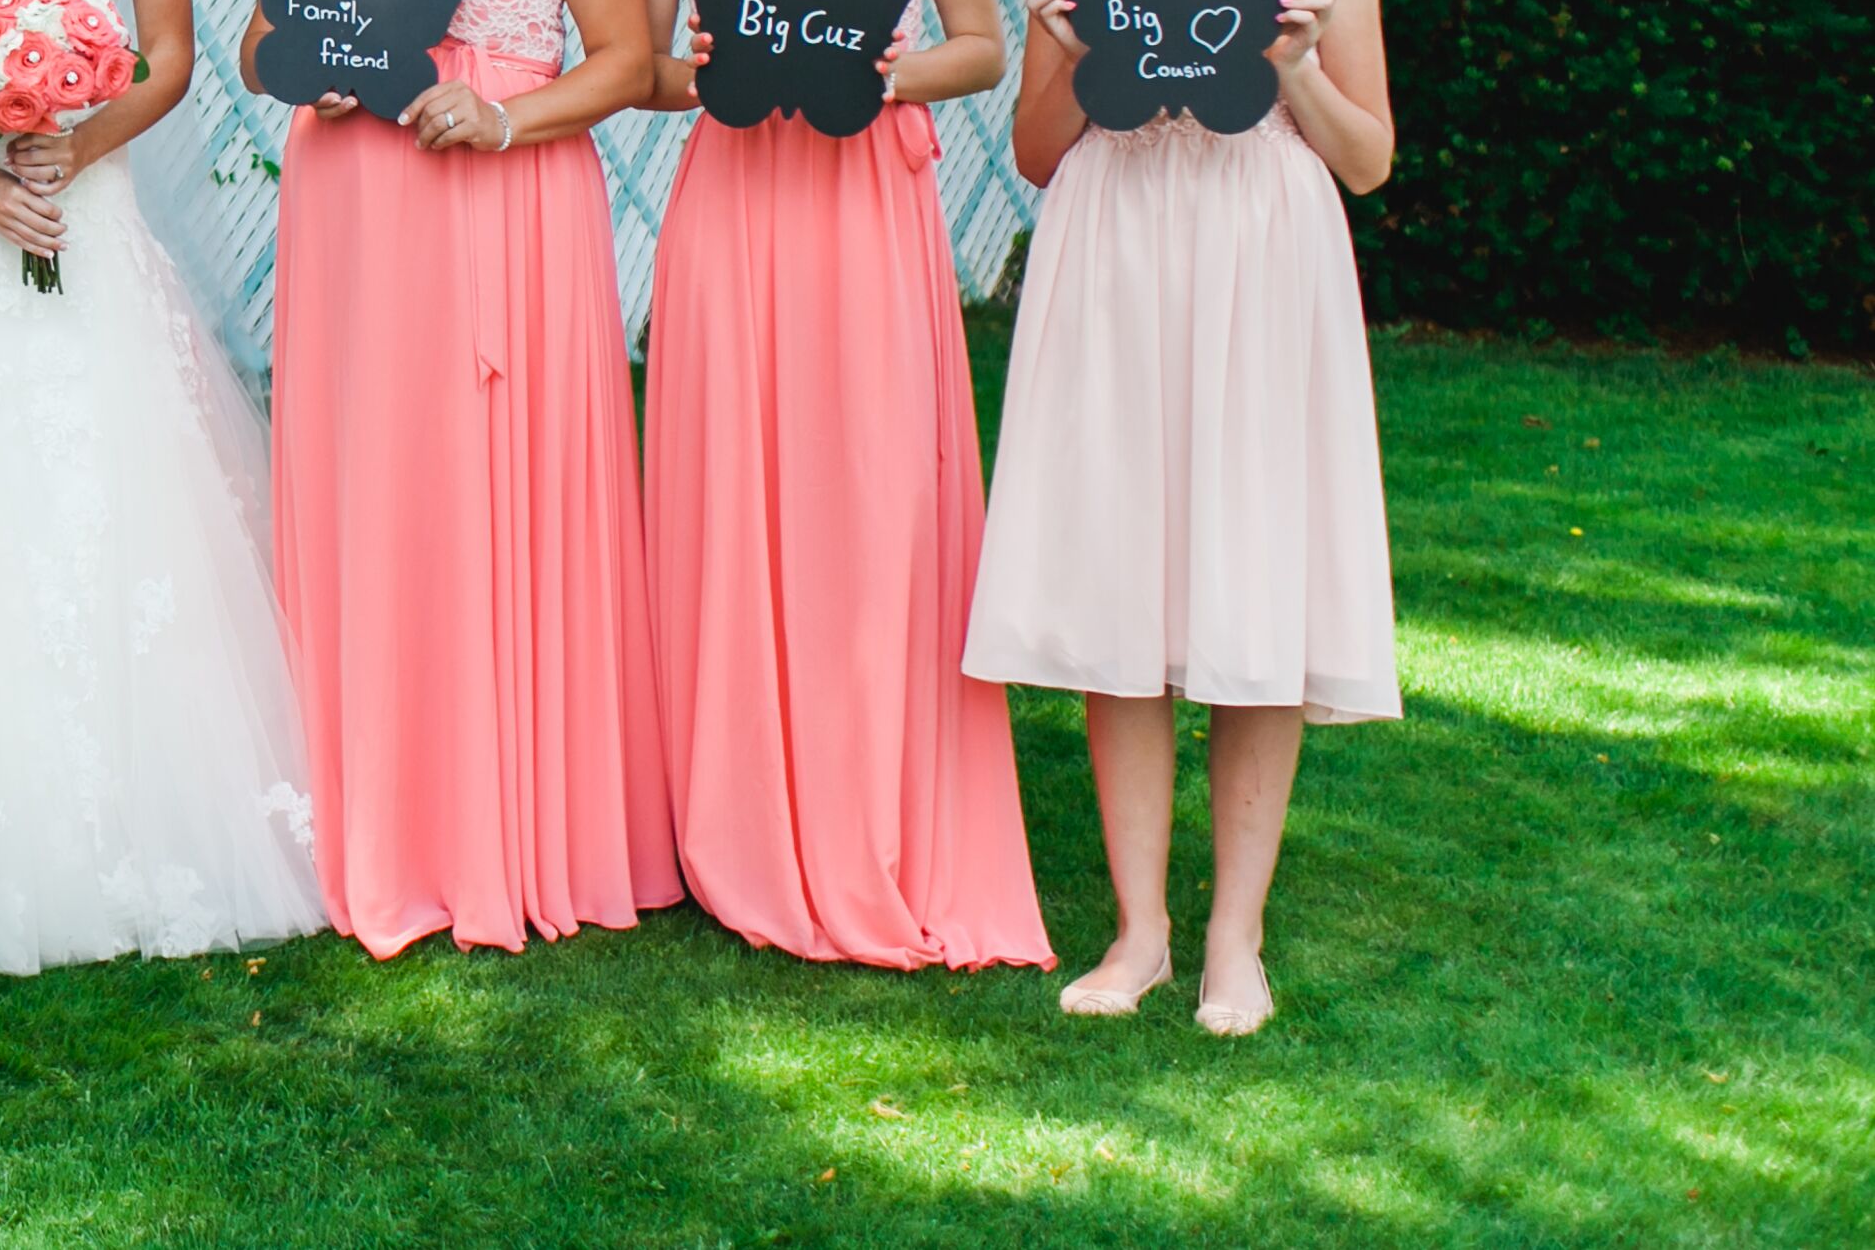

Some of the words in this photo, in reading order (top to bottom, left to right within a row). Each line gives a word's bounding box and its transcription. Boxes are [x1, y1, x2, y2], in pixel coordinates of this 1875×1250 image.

[800, 9, 866, 52] Cuz
[319, 37, 390, 71] friend
[1138, 52, 1217, 80] Cousin
